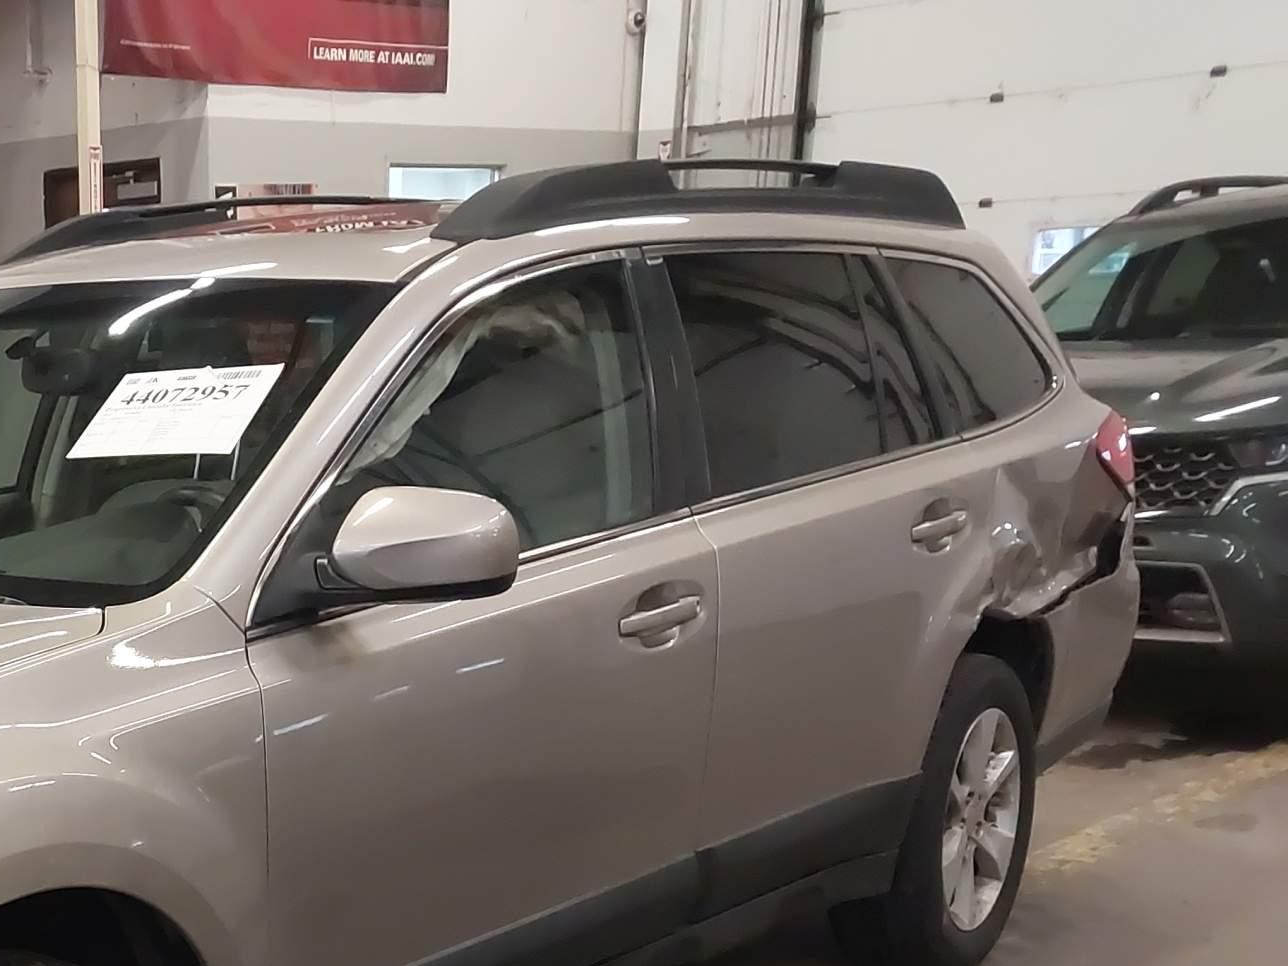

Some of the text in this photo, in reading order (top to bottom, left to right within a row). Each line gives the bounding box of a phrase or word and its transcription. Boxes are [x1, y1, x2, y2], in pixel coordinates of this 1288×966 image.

[313, 46, 436, 67] LEARN MORE AT IAAI.COM
[121, 384, 252, 406] 44072957
